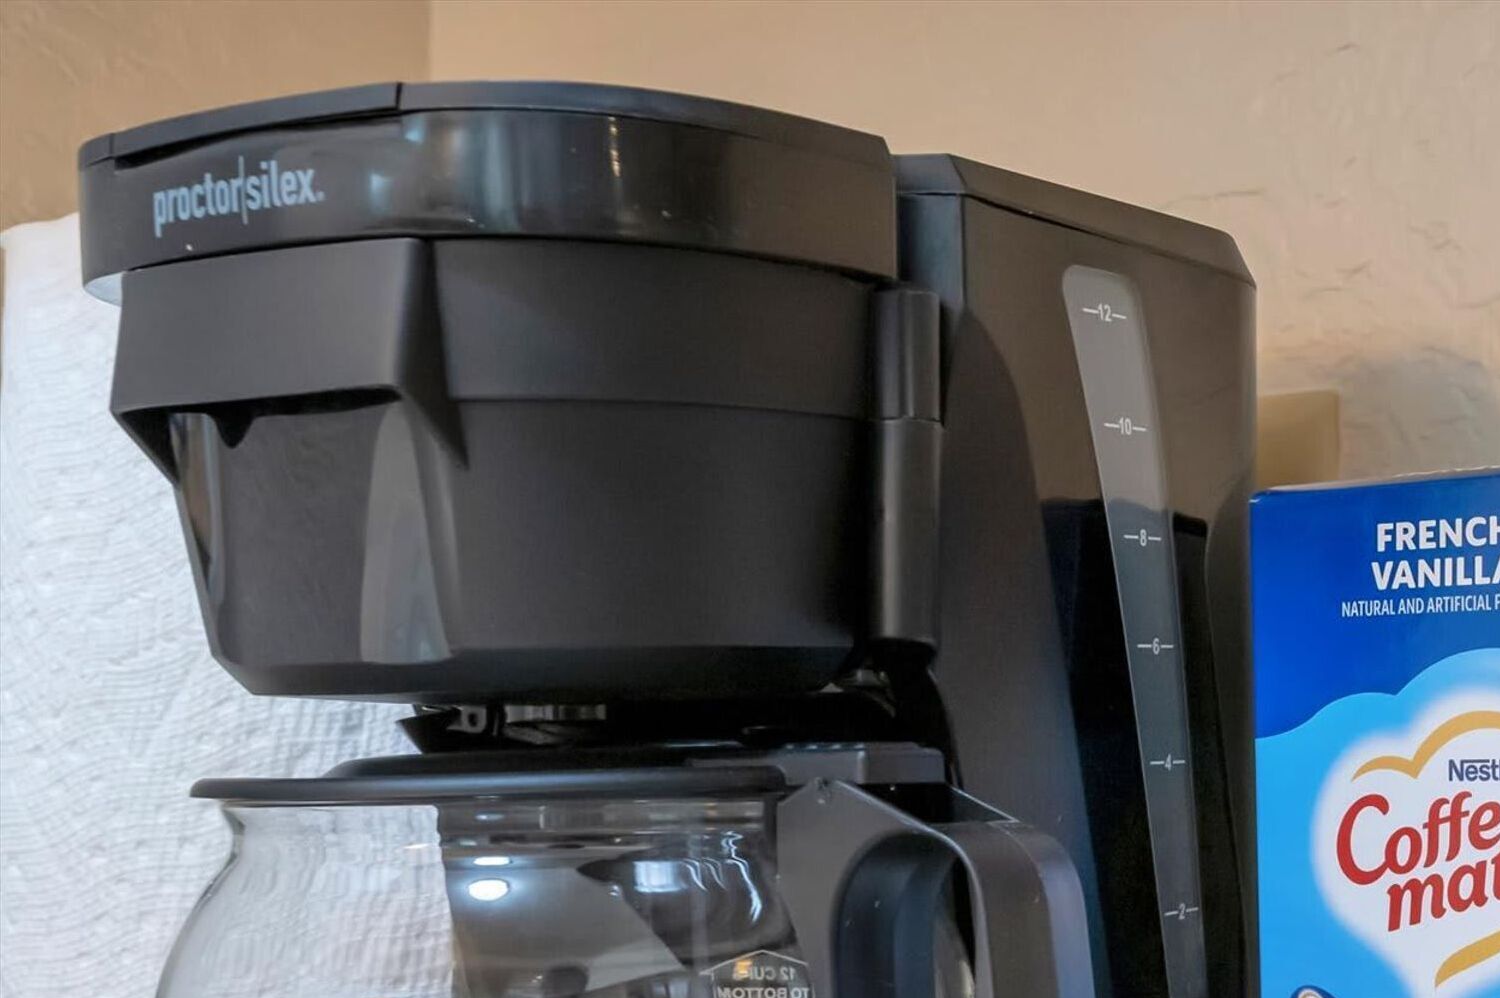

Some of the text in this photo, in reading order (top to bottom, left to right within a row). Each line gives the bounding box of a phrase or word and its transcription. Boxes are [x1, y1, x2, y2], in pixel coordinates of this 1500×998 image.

[1098, 303, 1112, 322] 12
[1118, 416, 1132, 436] 10
[1341, 600, 1396, 618] NATURAL
[1398, 597, 1425, 615] AND
[1427, 593, 1492, 613] ARTIFICIAL
